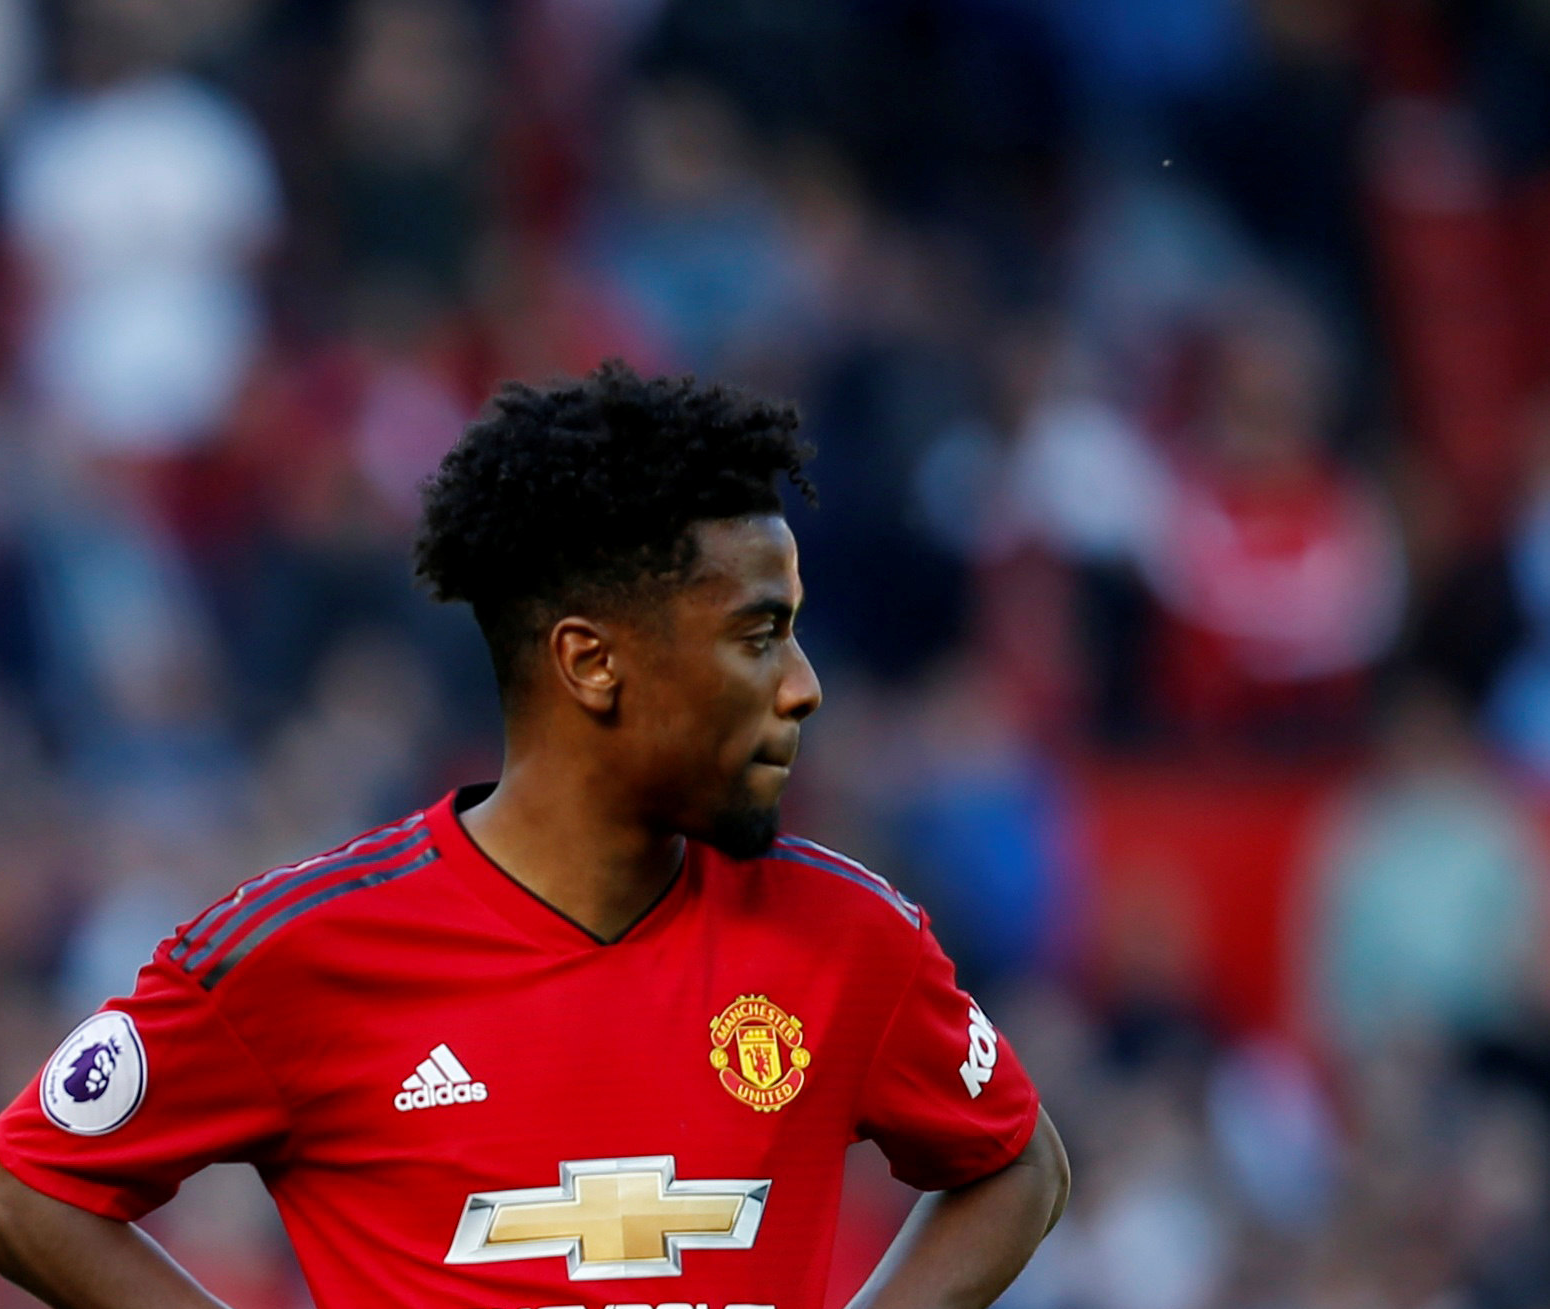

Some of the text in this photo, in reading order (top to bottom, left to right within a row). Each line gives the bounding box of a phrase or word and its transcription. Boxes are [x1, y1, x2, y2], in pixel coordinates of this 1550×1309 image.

[716, 1003, 796, 1041] MANCHESTER
[394, 1080, 488, 1112] adidas
[737, 1083, 793, 1104] UNITED
